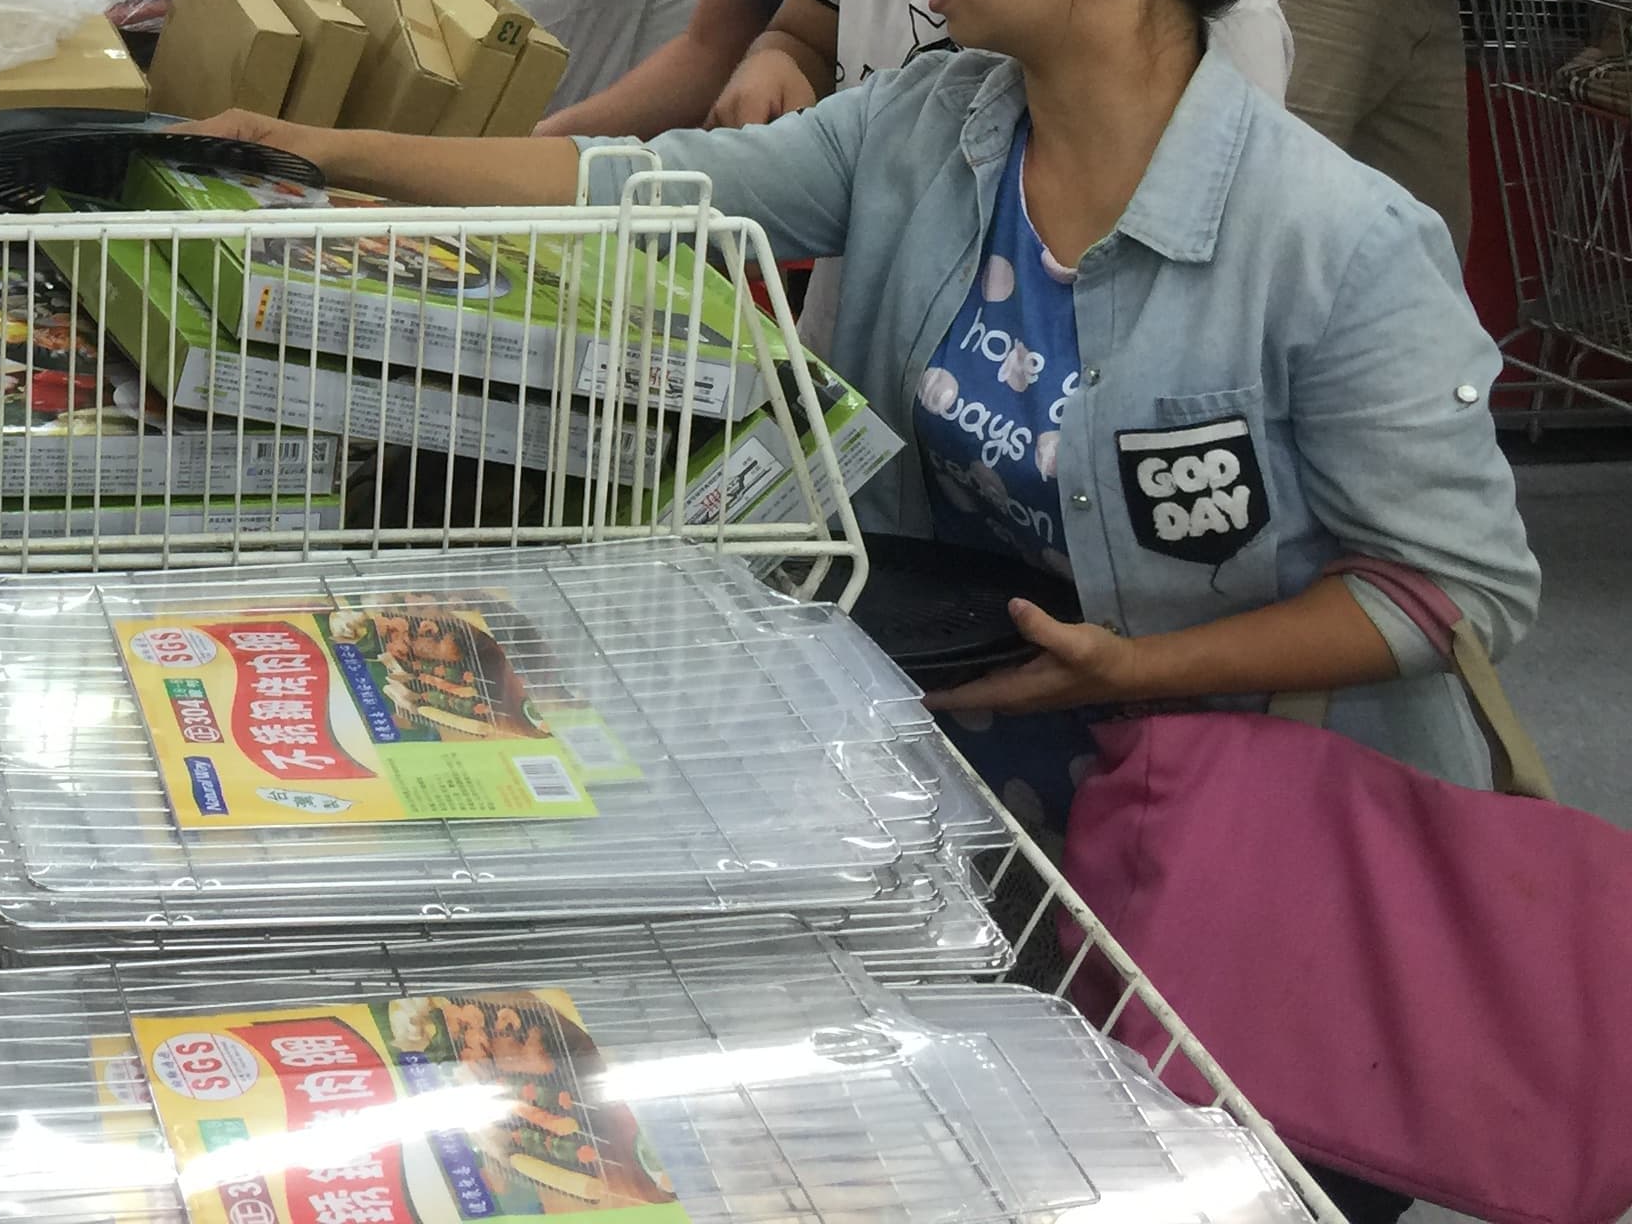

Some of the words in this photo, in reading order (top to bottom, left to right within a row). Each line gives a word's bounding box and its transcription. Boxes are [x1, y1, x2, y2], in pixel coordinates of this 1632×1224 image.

[1152, 484, 1252, 542] DAY
[150, 632, 194, 663] SGS
[193, 760, 211, 780] Way
[195, 779, 223, 812] Natural
[175, 1040, 231, 1091] SGS
